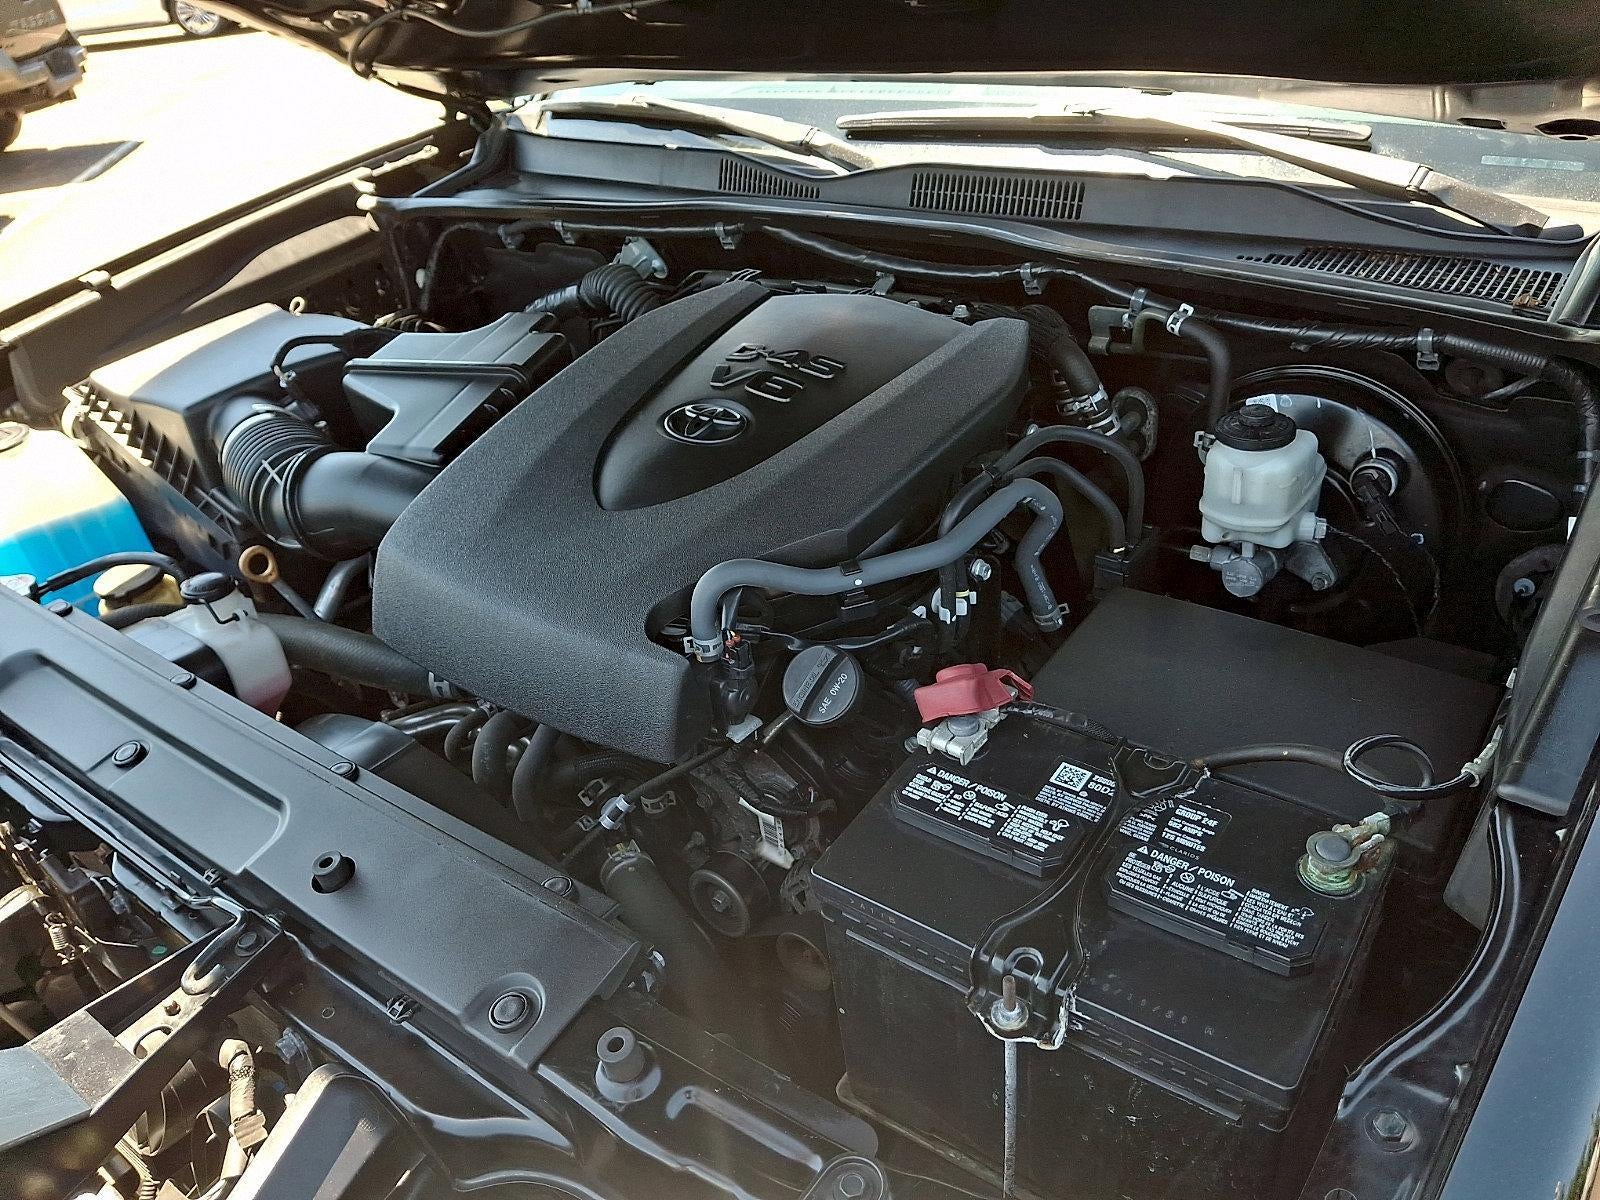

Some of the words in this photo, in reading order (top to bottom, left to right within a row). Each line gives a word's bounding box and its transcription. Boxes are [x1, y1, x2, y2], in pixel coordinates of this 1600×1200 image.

[710, 364, 806, 403] V6
[818, 697, 832, 714] SAE
[830, 673, 848, 696] 0W-20
[1174, 808, 1202, 822] GROUP
[1201, 817, 1219, 828] 24F
[1181, 825, 1203, 837] AMPS
[1170, 846, 1200, 860] CLARIOS
[1174, 836, 1206, 852] MINUTES
